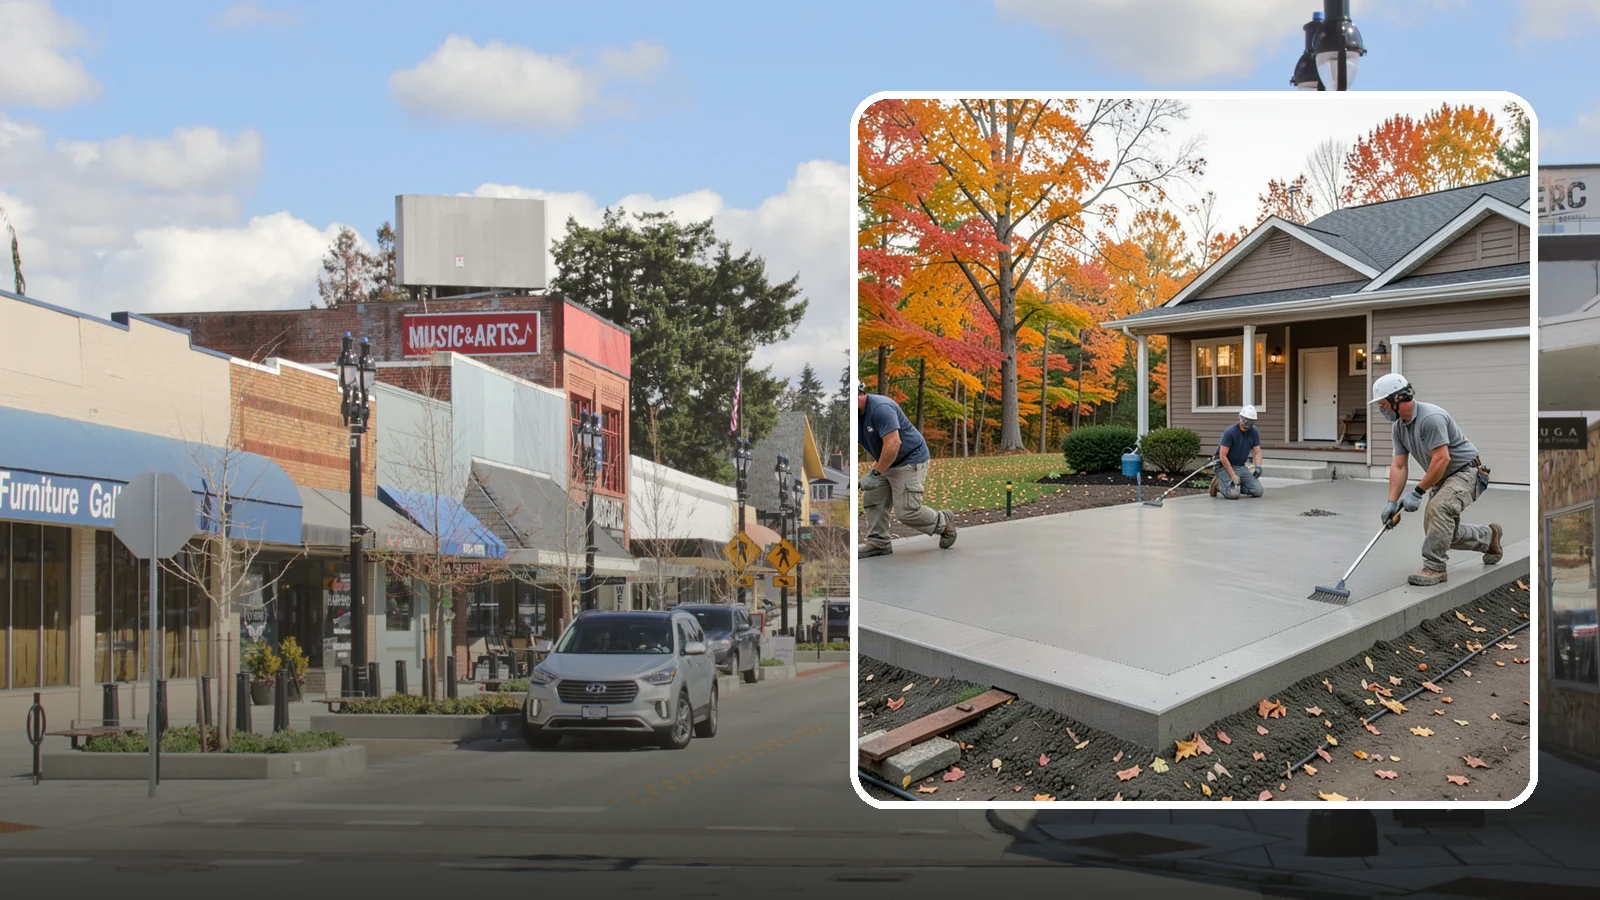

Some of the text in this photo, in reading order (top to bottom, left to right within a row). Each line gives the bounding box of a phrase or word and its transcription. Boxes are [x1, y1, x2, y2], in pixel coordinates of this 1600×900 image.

[408, 322, 520, 349] MUSIC&ARTS
[1540, 427, 1578, 437] UGA
[0, 471, 79, 516] Furniture
